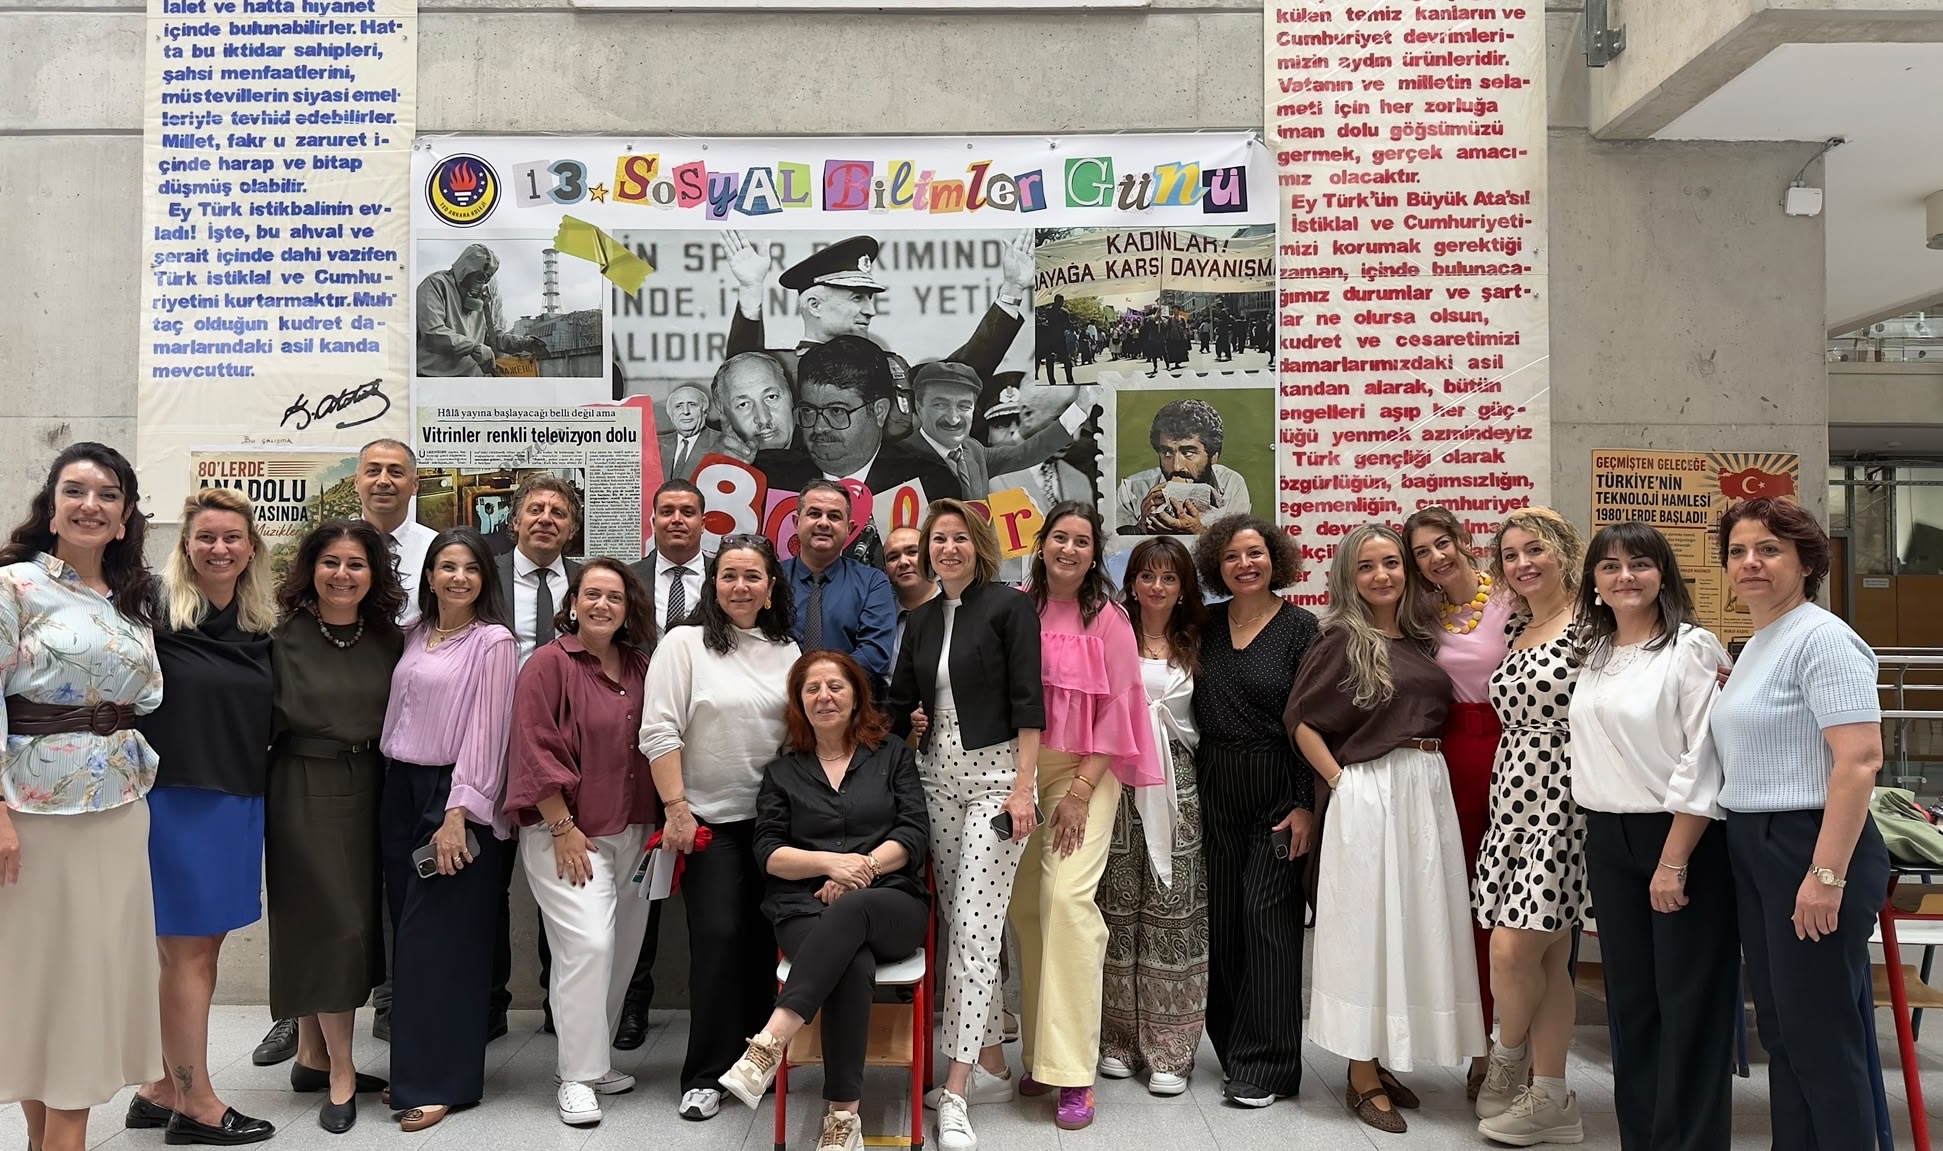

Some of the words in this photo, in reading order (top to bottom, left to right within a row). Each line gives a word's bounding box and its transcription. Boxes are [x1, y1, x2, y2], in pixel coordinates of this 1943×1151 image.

[214, 2, 236, 13] ve
[243, 0, 295, 14] hatta
[1277, 8, 1331, 23] külen
[1346, 8, 1402, 21] temiz
[1415, 5, 1496, 20] kanların
[1502, 9, 1525, 20] ve
[164, 22, 222, 41] içinde
[229, 20, 356, 36] bulunabilirler.
[360, 20, 402, 34] Hat-
[1277, 30, 1392, 48] Cumhuriyet
[1403, 28, 1514, 44] devrimleri-
[164, 45, 184, 59] ta
[192, 44, 216, 59] bu
[223, 43, 285, 58] iktidar
[294, 43, 384, 60] sahipleri,
[1278, 55, 1328, 69] mizin
[1402, 50, 1509, 68] ürünleridir.
[163, 66, 214, 84] şahsi
[221, 65, 356, 82] menfaatlerini,
[1278, 78, 1353, 93] Vatanın
[1362, 80, 1384, 91] ve
[1399, 74, 1472, 90] milletin
[1480, 74, 1530, 90] sela-
[161, 88, 289, 104] müstevillerin
[291, 88, 351, 107] siyasi
[1276, 101, 1323, 116] meti
[1335, 101, 1370, 118] için
[1380, 100, 1413, 113] her
[1425, 98, 1499, 118] zorluğa
[162, 111, 224, 129] leriyle
[231, 110, 291, 126] tevhid
[295, 110, 396, 125] edebilirler.
[1278, 125, 1325, 139] iman
[1337, 123, 1379, 138] dolu
[1391, 120, 1504, 142] göğsümüzü
[161, 134, 221, 150] Millet,
[227, 133, 266, 148] fakr
[274, 137, 286, 149] u
[296, 133, 367, 148] zaruret
[374, 132, 389, 146] i-
[159, 157, 211, 176] çinde
[218, 157, 275, 173] harap
[283, 159, 306, 170] ve
[312, 155, 363, 172] bitap
[1278, 147, 1360, 167] germek,
[1372, 145, 1442, 165] gerçek
[1457, 147, 1527, 160] amacı-
[527, 160, 583, 200] 13
[1068, 161, 1241, 210] Günü
[1279, 175, 1311, 186] mız
[1330, 169, 1420, 184] olacaktır.
[159, 179, 233, 198] düşmüş
[240, 178, 306, 193] olabilir.
[1291, 195, 1317, 214] Ey
[1323, 191, 1399, 208] Türk'ün
[1407, 191, 1468, 210] Büyük
[1473, 190, 1530, 206] Ata'sı!
[168, 202, 191, 224] Ey
[198, 202, 242, 217] Türk
[249, 201, 354, 217] istikbalinin
[359, 204, 391, 216] ev-
[154, 224, 197, 241] ladı!
[208, 222, 251, 243] İşte,
[256, 225, 281, 240] bu
[290, 224, 344, 239] ahval
[350, 227, 375, 239] ve
[1292, 214, 1360, 233] İstiklal
[1371, 219, 1394, 230] ve
[1403, 214, 1532, 233] Cumhuriyeti-
[1107, 230, 1229, 254] KADINLAR!
[1280, 241, 1319, 256] mizi
[1332, 238, 1421, 255] korumak
[1434, 237, 1522, 256] gerektiği
[155, 248, 209, 268] şerait
[216, 248, 274, 266] içinde
[280, 247, 322, 262] dahi
[327, 247, 397, 262] vazifen
[154, 271, 197, 287] Türk
[207, 270, 272, 286] istiklal
[281, 272, 305, 284] ve
[315, 269, 392, 285] Cumhu-
[1280, 267, 1348, 281] zaman,
[1361, 262, 1420, 282] içinde
[1432, 261, 1531, 276] bulunaca-
[153, 294, 220, 312] riyetini
[224, 292, 353, 308] kurtarmaktır.
[1280, 289, 1329, 308] ğımız
[1343, 285, 1433, 302] durumlar
[1446, 288, 1470, 299] ve
[1482, 284, 1531, 302] şart-
[153, 319, 183, 336] taç
[194, 317, 269, 336] olduğun
[279, 316, 342, 331] kudret
[351, 315, 385, 330] da-
[1316, 314, 1341, 326] ne
[1354, 310, 1416, 326] olursa
[1430, 308, 1488, 325] olsun,
[153, 339, 273, 355] marlarındaki
[281, 339, 315, 353] asil
[320, 338, 380, 353] kanda
[1280, 334, 1342, 350] kudret
[1357, 336, 1381, 348] ve
[1396, 331, 1520, 348] cesaretimizi
[152, 363, 254, 378] mevcuttur.
[1468, 355, 1504, 369] asil
[1280, 381, 1350, 397] kandan
[1364, 379, 1433, 397] alarak,
[1443, 378, 1502, 394] bütün
[462, 411, 491, 419] yayına
[494, 409, 547, 419] başlayacağı
[550, 409, 569, 417] belli
[572, 409, 594, 419] değil
[1280, 404, 1366, 425] engelleri
[1380, 406, 1422, 422] aşıp
[1432, 403, 1465, 417] her
[1478, 402, 1525, 421] güç-
[423, 427, 480, 442] Vitrinler
[487, 427, 526, 443] renkli
[531, 427, 600, 446] televizyon
[606, 427, 636, 442] dolu
[1332, 427, 1412, 448] yenmek
[1422, 425, 1532, 444] azmindeyiz
[1292, 451, 1340, 467] Türk
[1354, 449, 1432, 470] gençliği
[1442, 448, 1505, 464] olarak
[1597, 455, 1654, 472] GEÇMİŞTEN
[1658, 457, 1706, 471] GELECEĞE
[198, 462, 265, 477] 80'LERDE
[1280, 475, 1392, 495] özgürlüğün,
[1401, 472, 1535, 493] bağımsızlığın,
[1596, 472, 1682, 490] TÜRKİYE'NİN
[1280, 496, 1403, 518] egemenliğin,
[1596, 491, 1658, 506] TEKNOLOJİ
[1663, 493, 1711, 507] HAMLESİ
[1596, 508, 1657, 523] 1980'LERDE
[1660, 509, 1707, 525] BAŞLADI!
